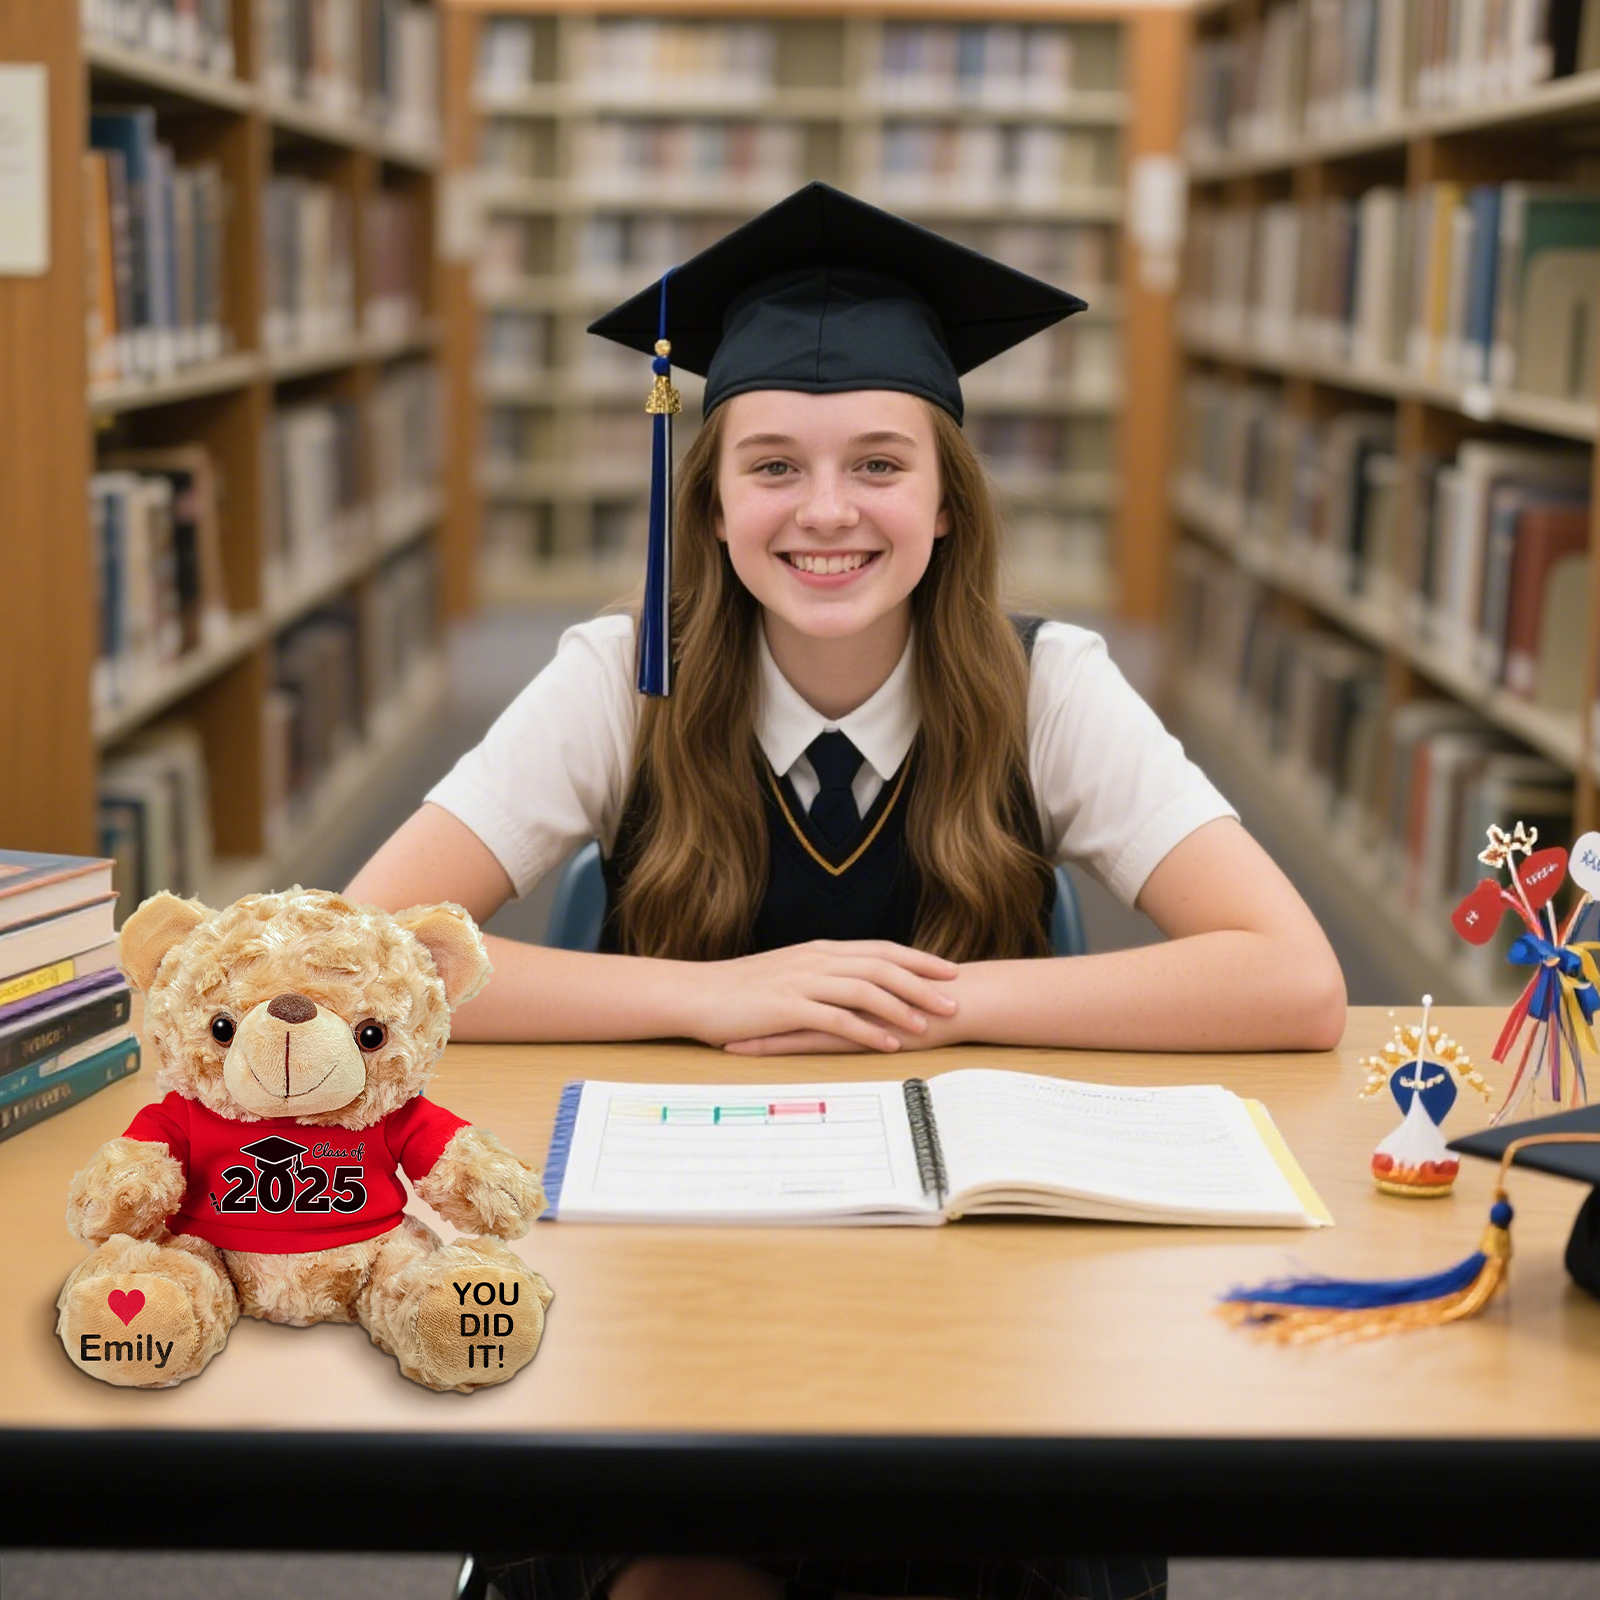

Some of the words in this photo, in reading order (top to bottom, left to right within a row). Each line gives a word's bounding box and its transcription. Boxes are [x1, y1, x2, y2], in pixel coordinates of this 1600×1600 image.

[312, 1141, 348, 1159] Class
[351, 1142, 365, 1162] of
[221, 1165, 368, 1214] 2025
[453, 1281, 520, 1306] YOU
[460, 1313, 514, 1337] DID
[80, 1334, 174, 1368] Emily
[467, 1343, 504, 1368] IT!
